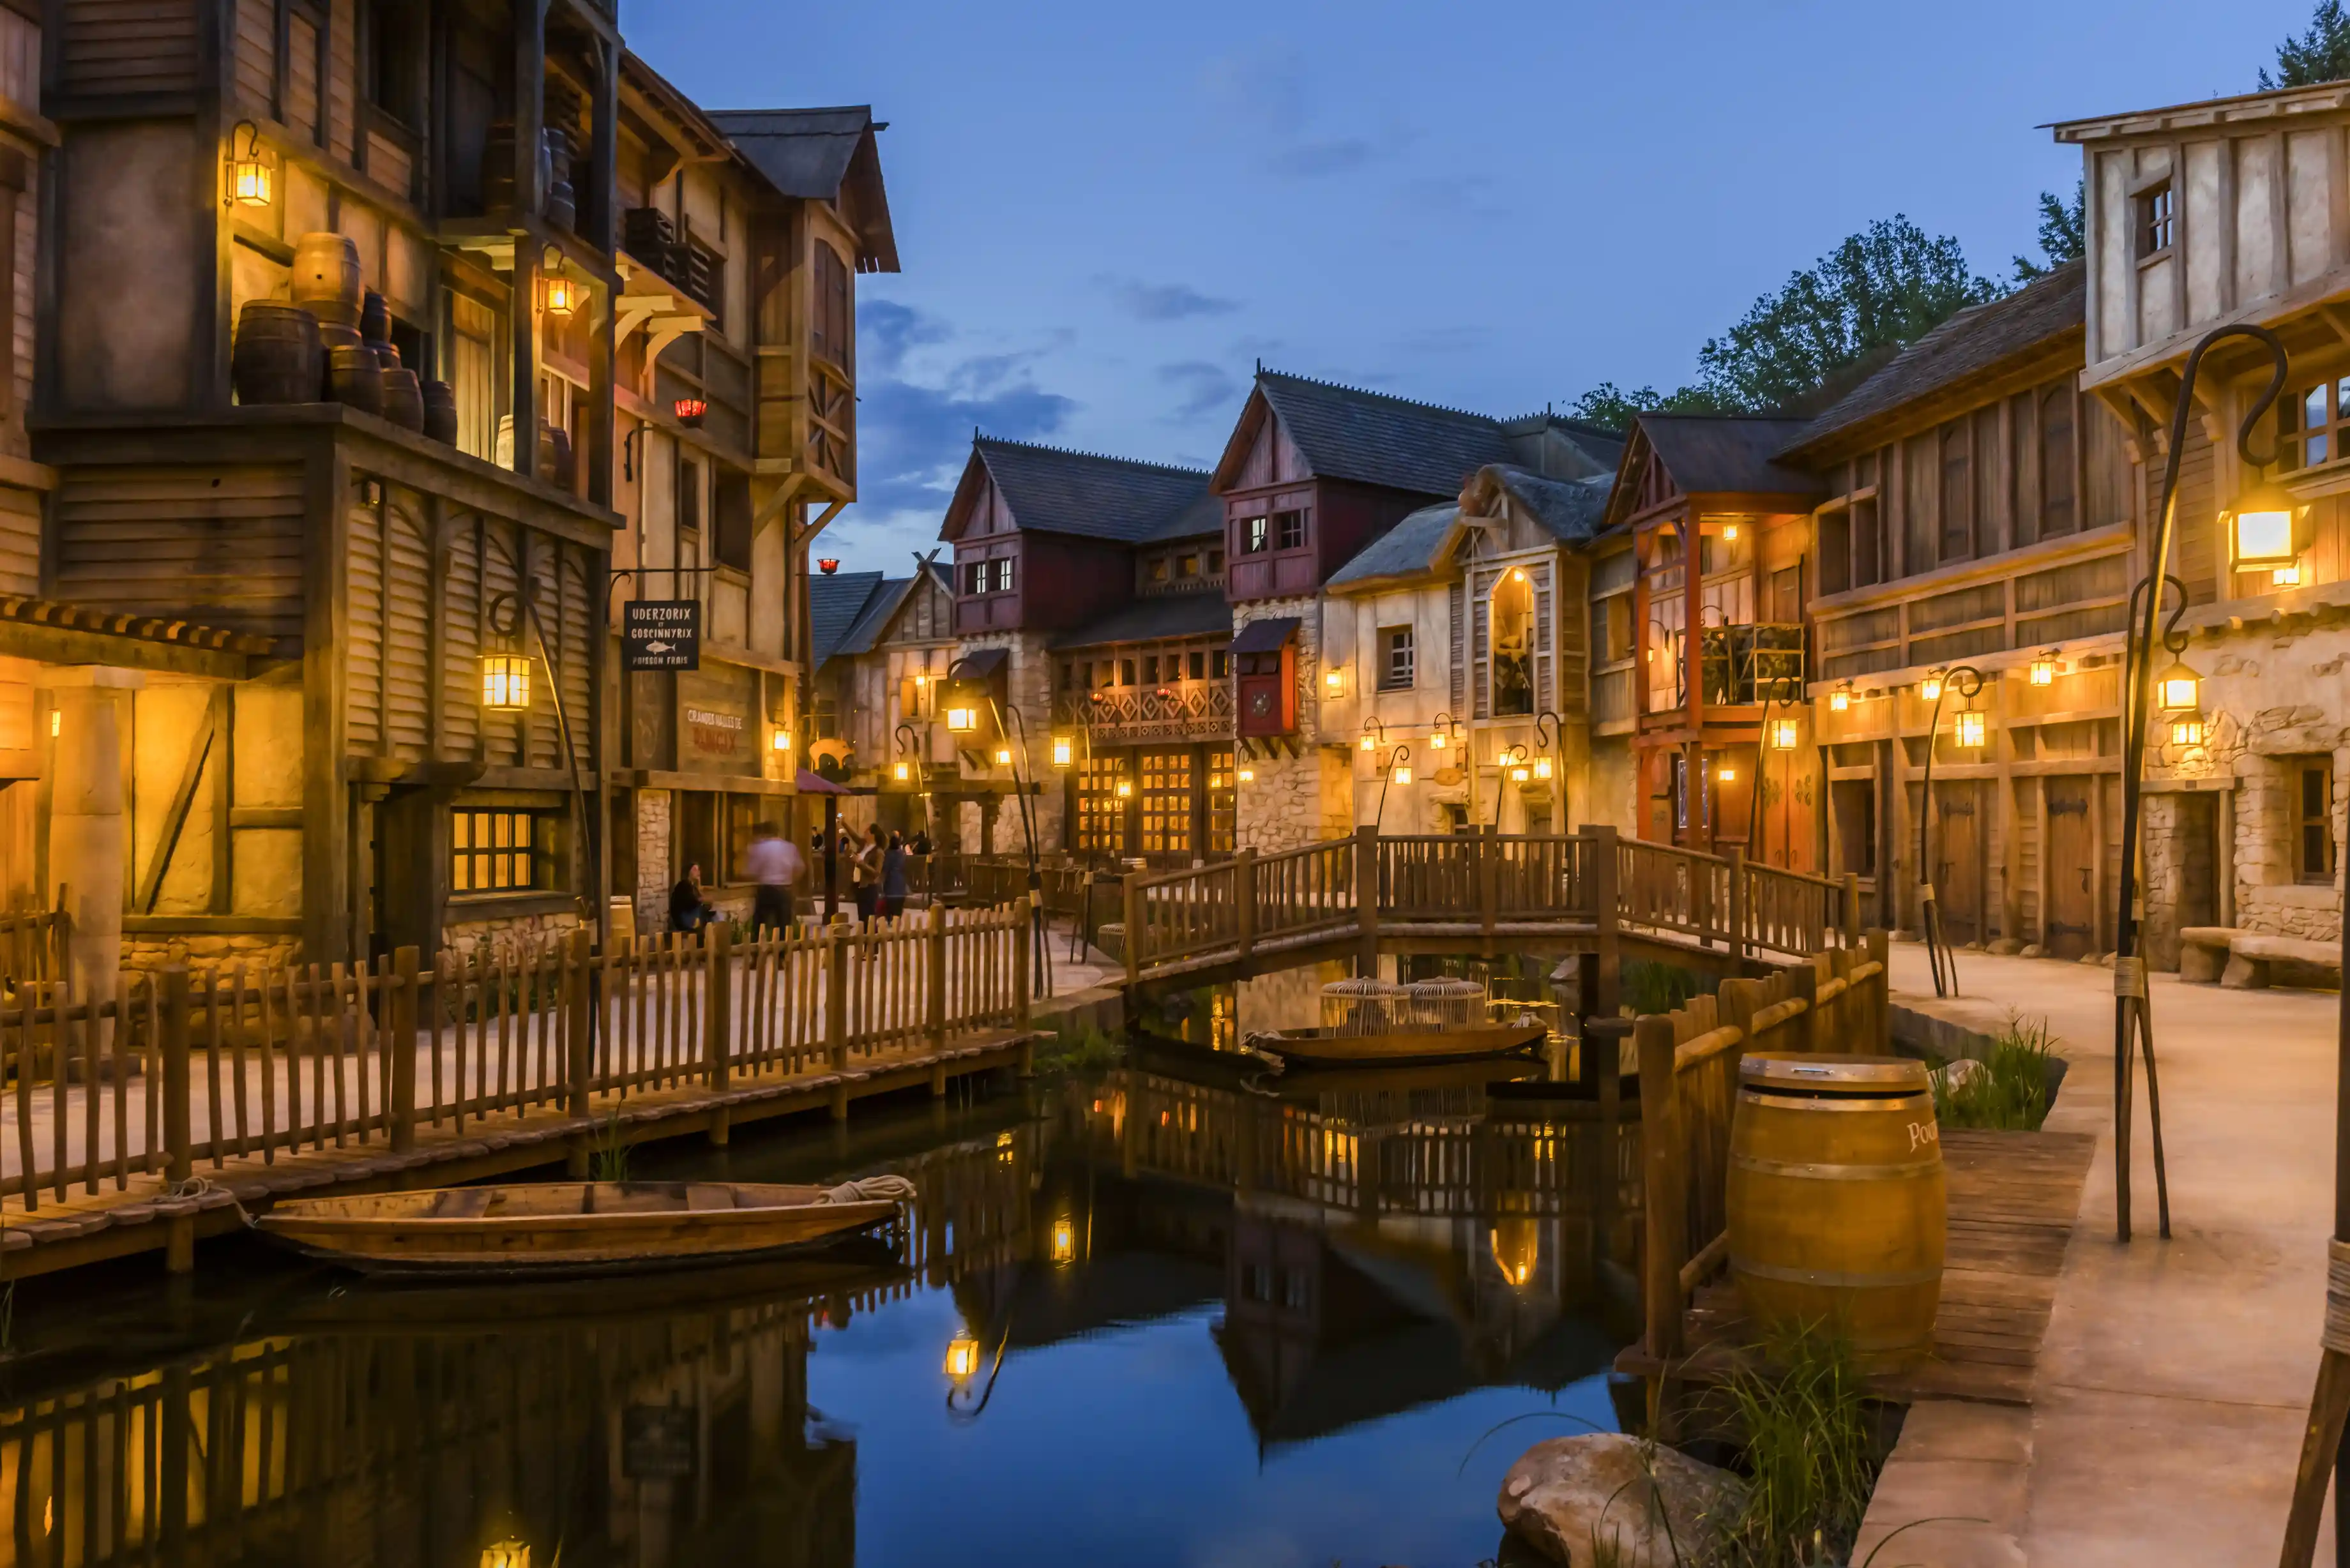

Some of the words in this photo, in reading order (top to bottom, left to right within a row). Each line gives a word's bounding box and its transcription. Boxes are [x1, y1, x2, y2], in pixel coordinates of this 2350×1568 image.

[632, 608, 691, 621] UDERZORIX
[631, 628, 692, 638] GOSCINNYRIX
[632, 656, 663, 665] POISSON
[667, 656, 688, 665] FRAIS
[735, 717, 742, 730] DE
